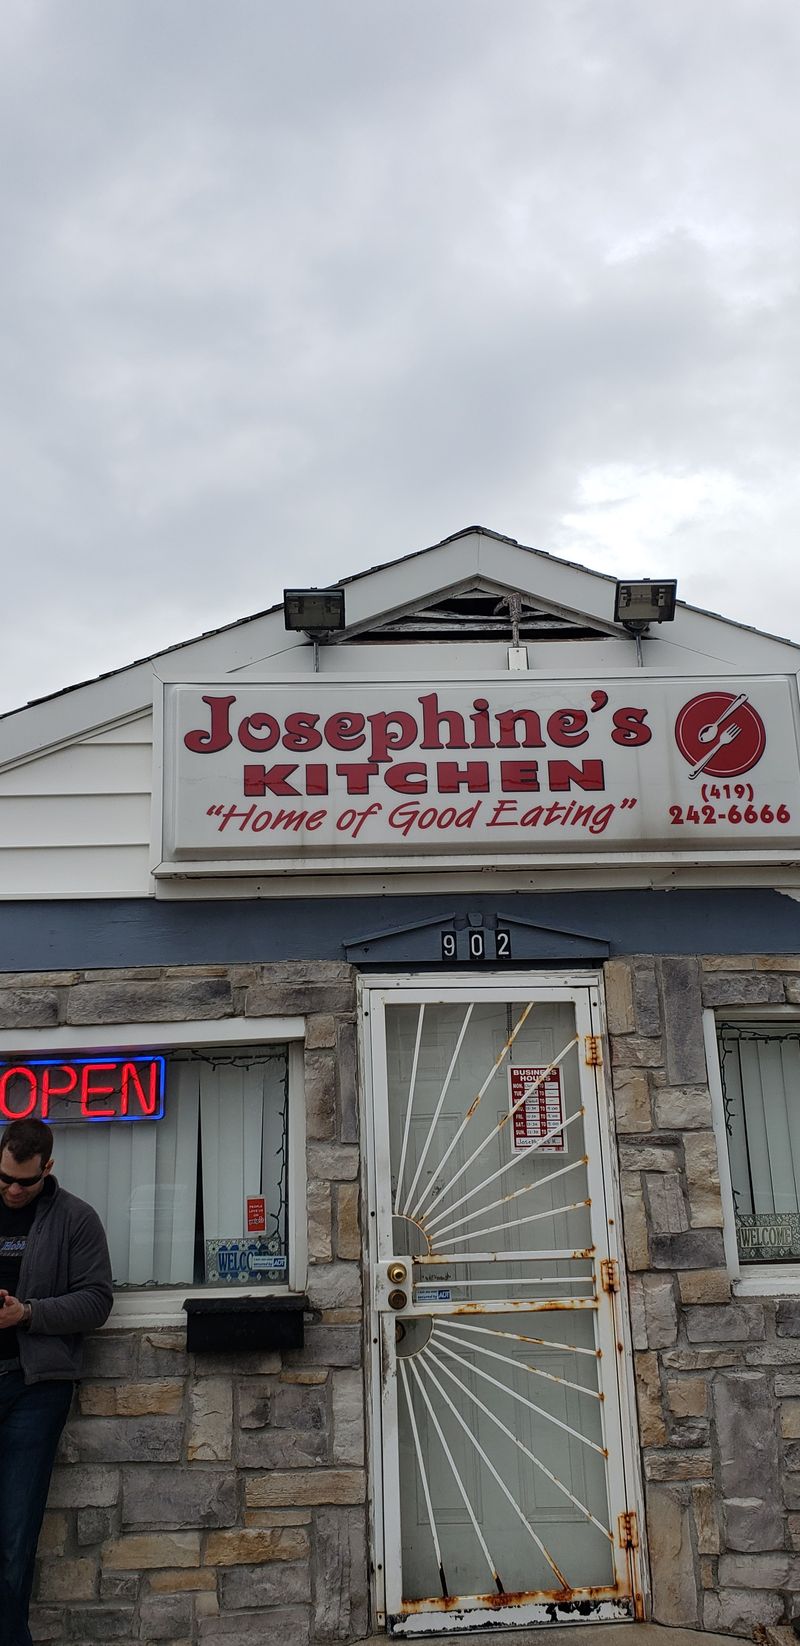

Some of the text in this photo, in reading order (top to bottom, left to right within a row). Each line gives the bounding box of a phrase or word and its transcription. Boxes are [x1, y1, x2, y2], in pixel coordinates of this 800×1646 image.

[183, 689, 652, 763] Josephine's
[243, 759, 606, 797] KITCHEN
[701, 783, 754, 803] (419)
[335, 802, 382, 838] of
[388, 800, 483, 837] Good
[668, 804, 791, 825] 242-6666
[443, 932, 510, 957] 902
[0, 1062, 157, 1120] OPEN
[741, 1227, 791, 1247] WELCOME
[218, 1252, 254, 1271] WELCO
